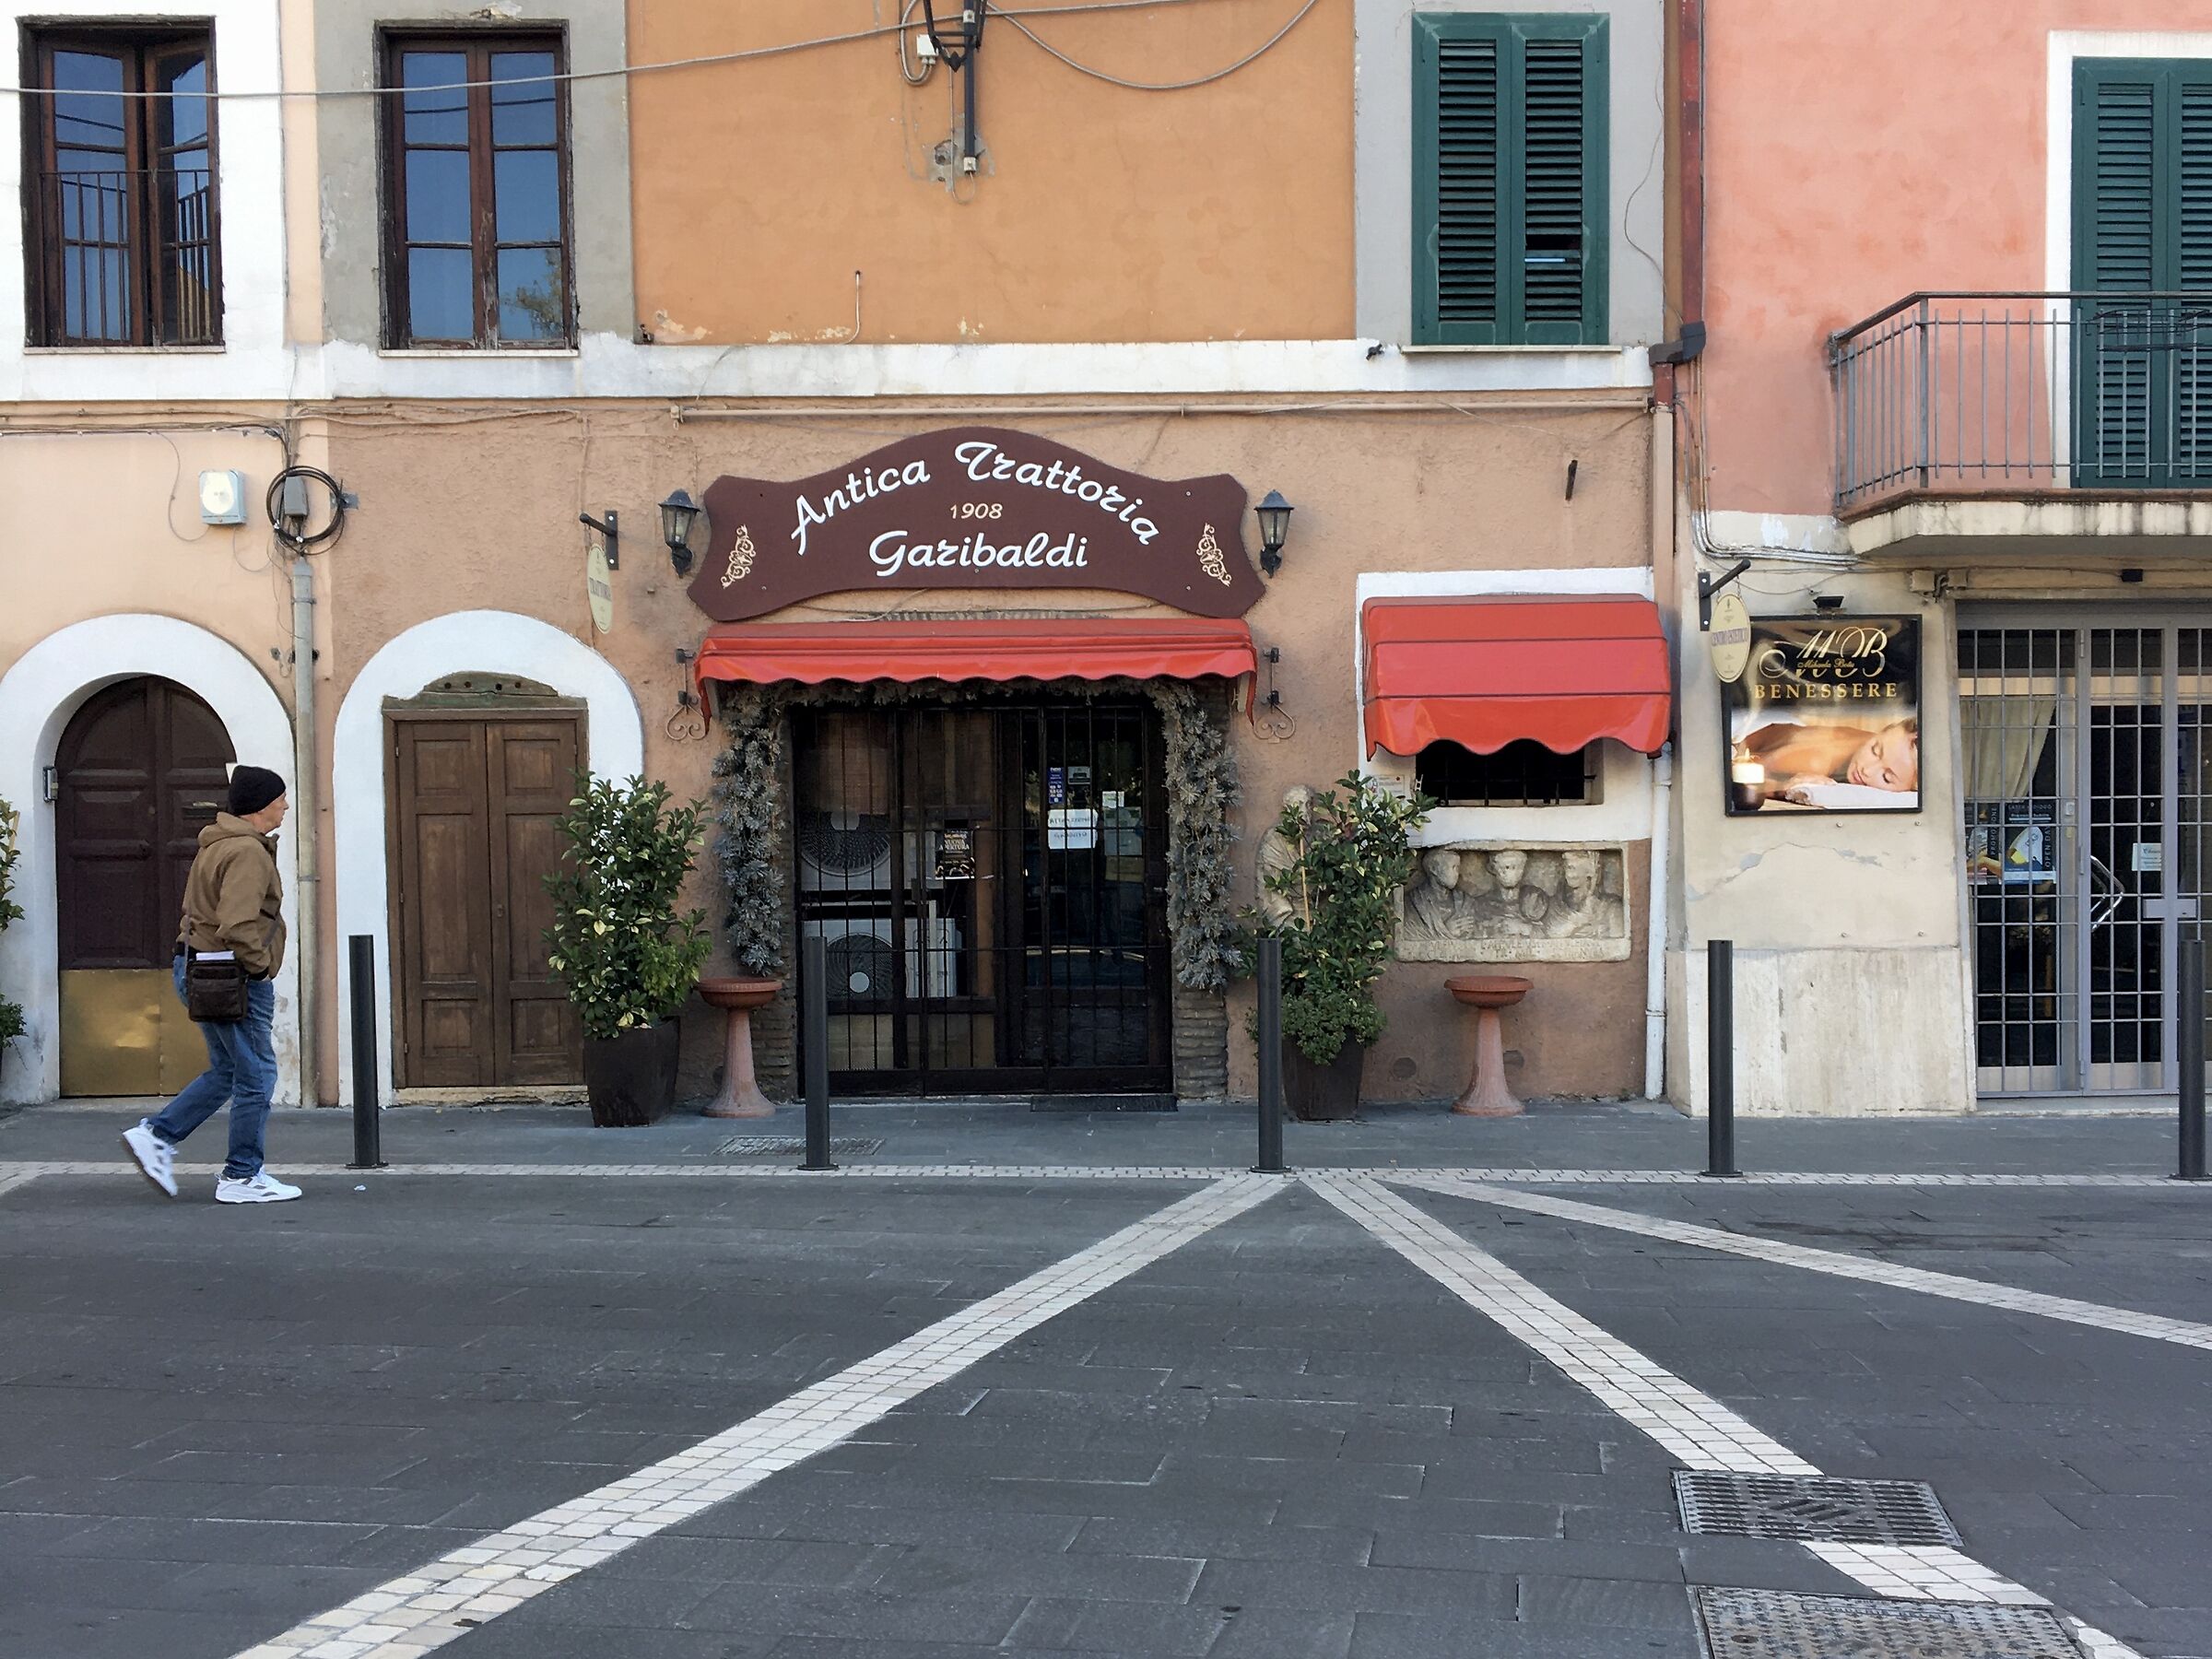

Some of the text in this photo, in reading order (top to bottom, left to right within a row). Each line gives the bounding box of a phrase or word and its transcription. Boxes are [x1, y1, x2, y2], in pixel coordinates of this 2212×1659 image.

[791, 441, 1161, 555] Antica Trattoria
[950, 502, 1003, 520] 1908
[868, 531, 1088, 578] Garibaldi
[1754, 682, 1898, 700] BENESSERE
